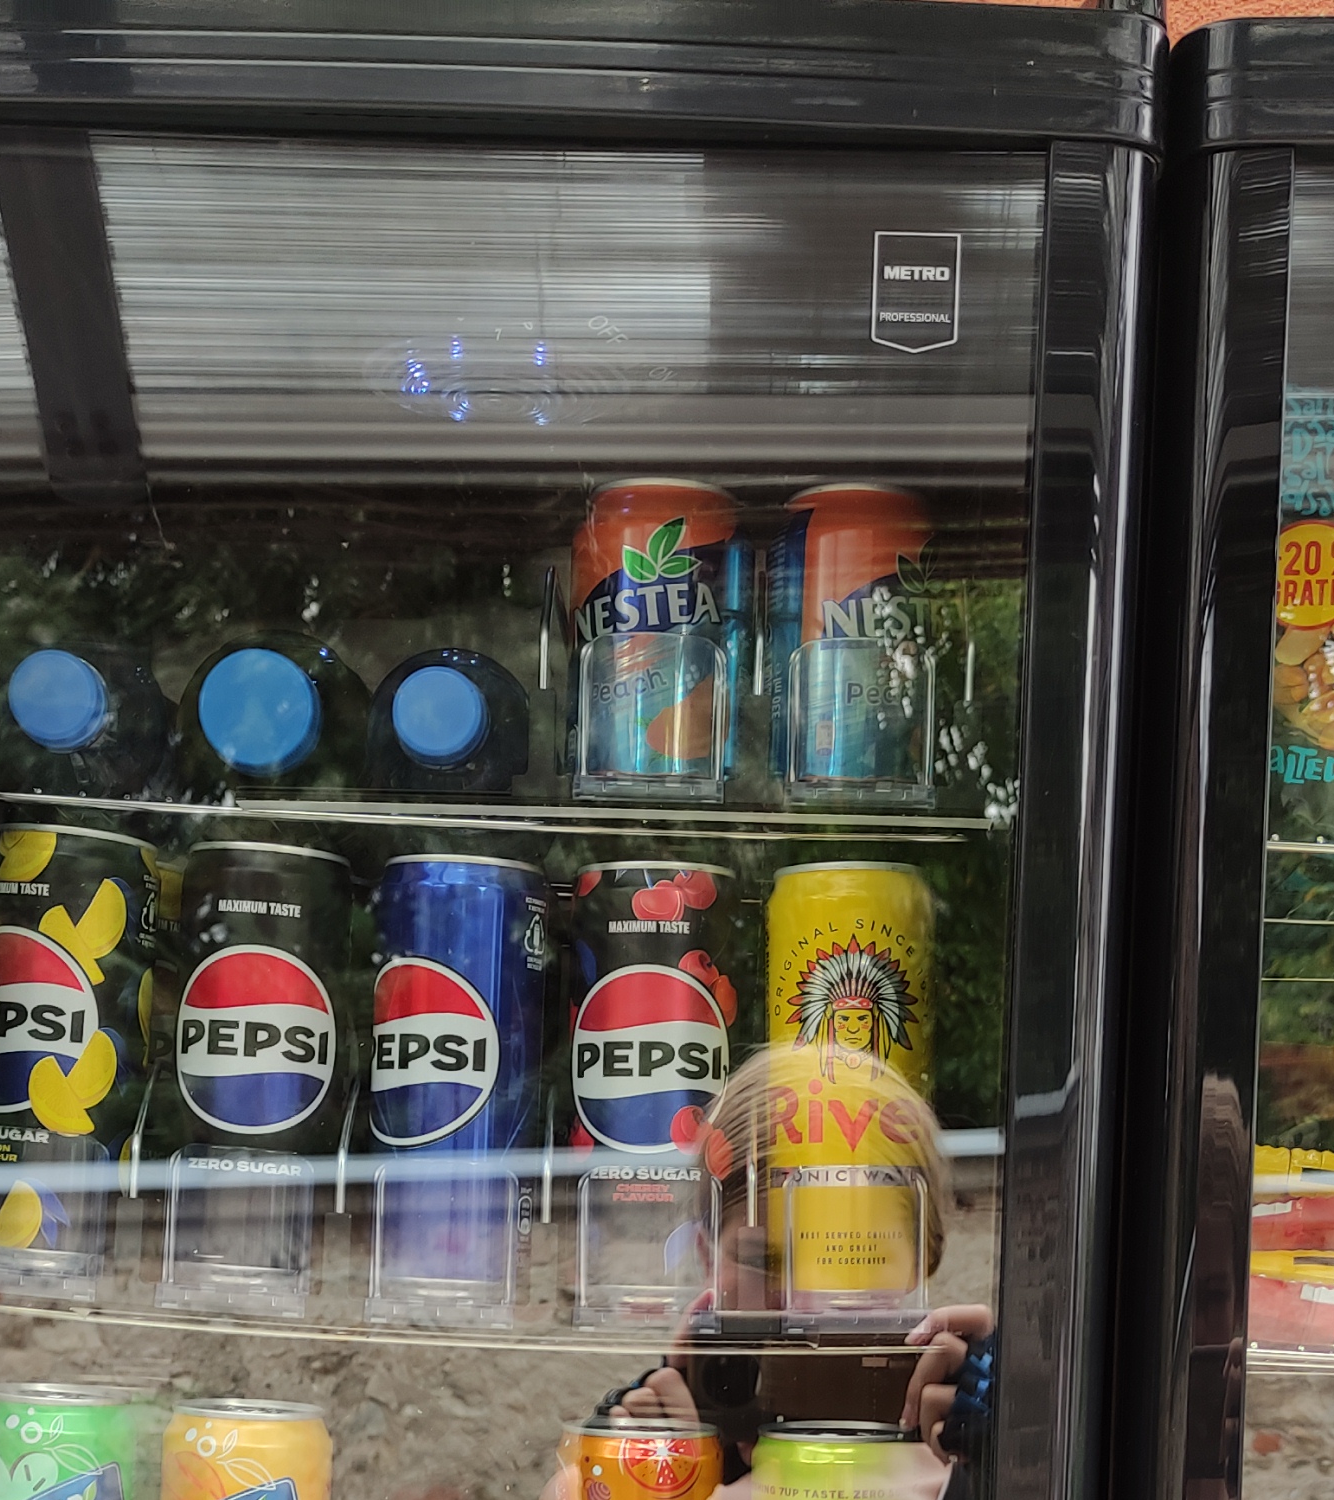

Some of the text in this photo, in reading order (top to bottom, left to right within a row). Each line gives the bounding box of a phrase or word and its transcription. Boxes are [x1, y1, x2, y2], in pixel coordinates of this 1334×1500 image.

[883, 265, 950, 281] METRO
[879, 311, 952, 324] PROFESSIONAL
[574, 582, 721, 650] NESTEA
[18, 882, 50, 897] TASTE
[218, 899, 302, 918] MAXIMUM TASTE
[608, 919, 691, 935] MAXIMUM TASTE
[774, 921, 839, 1017] ORIGINAL
[855, 918, 916, 958] SINCE
[180, 1019, 329, 1066] PEPSI
[576, 1039, 723, 1081] PEPSI
[769, 1078, 920, 1154] Rive
[187, 1157, 303, 1178] ZERO SUGAR
[589, 1165, 702, 1182] ZERO SUGAR
[782, 1169, 848, 1183] TONIC
[615, 1183, 671, 1193] CHERRY
[612, 1192, 674, 1203] FLAVOUR
[825, 1231, 861, 1240] SERVED
[825, 1244, 878, 1253] AND GREAT
[816, 1257, 833, 1266] FOR
[779, 1486, 799, 1498] 7UP
[803, 1489, 849, 1500] TASTE.
[853, 1489, 885, 1500] ZERO
